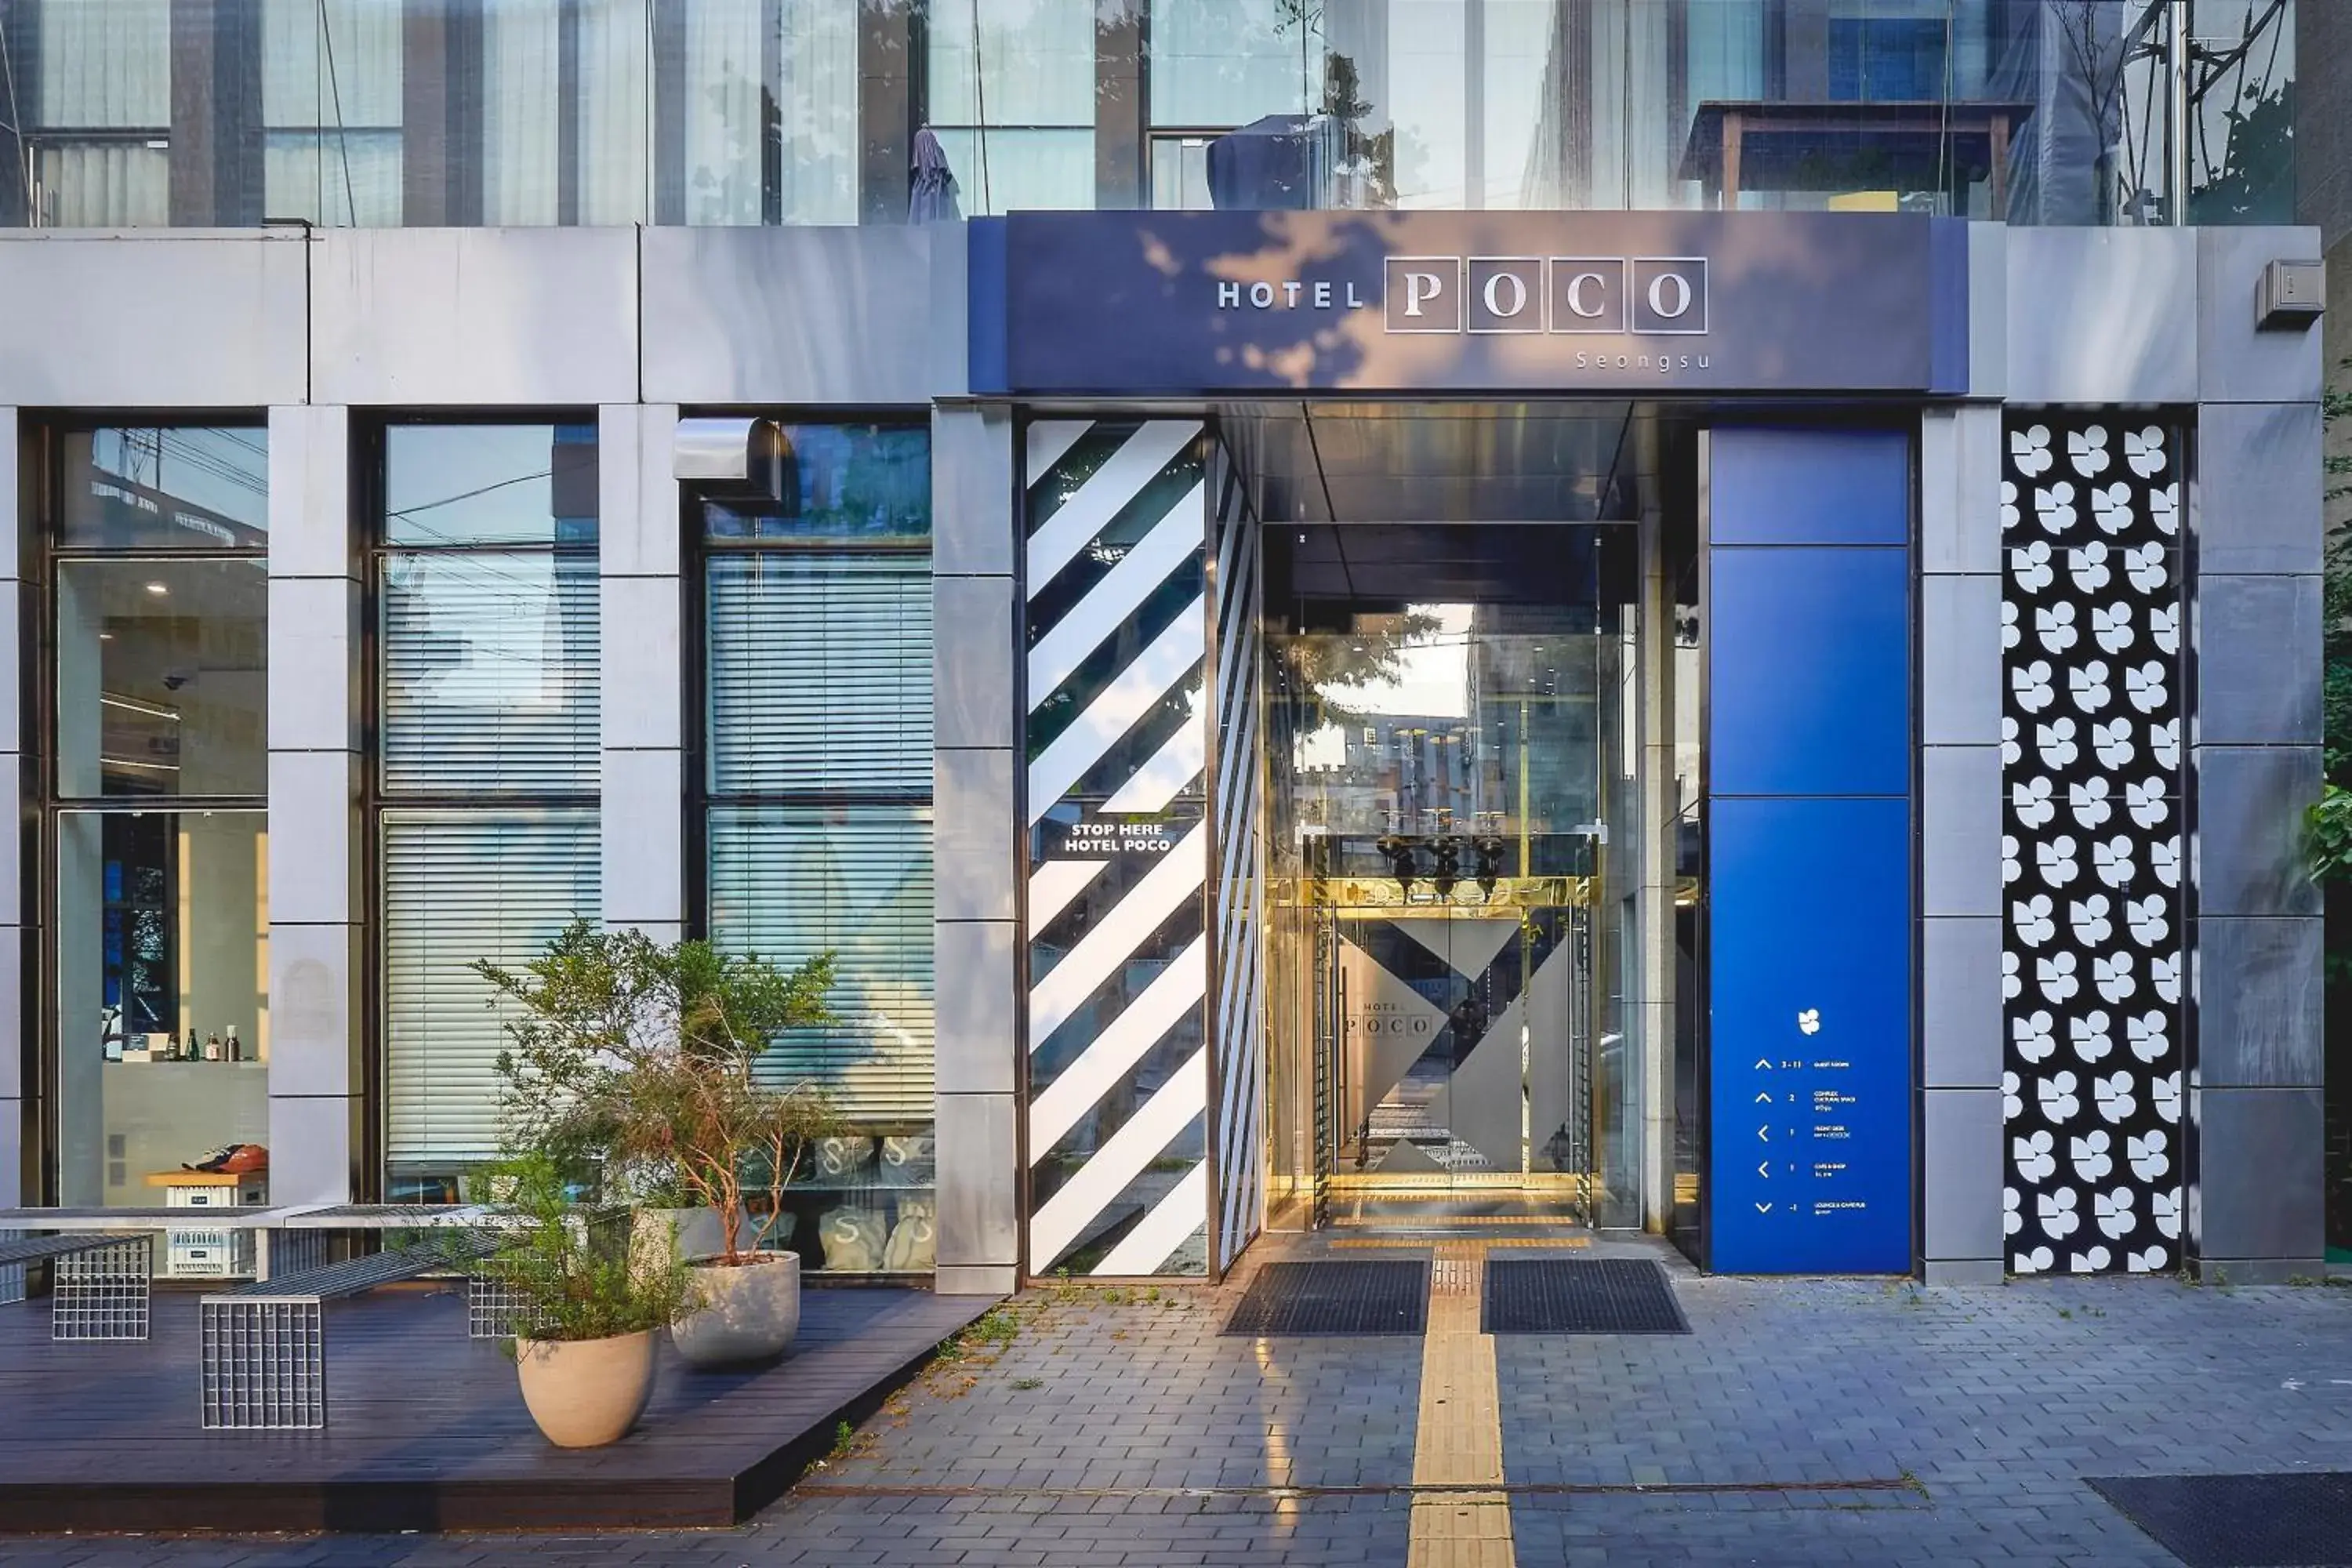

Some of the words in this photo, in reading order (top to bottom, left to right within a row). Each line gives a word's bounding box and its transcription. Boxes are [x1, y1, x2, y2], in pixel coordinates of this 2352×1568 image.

[1218, 281, 1364, 310] HOTEL
[1403, 272, 1692, 318] POCO
[1576, 350, 1710, 372] Seongsu
[1072, 824, 1115, 836] STOP
[1119, 824, 1163, 836] HERE
[1065, 840, 1120, 851] HOTEL
[1124, 840, 1171, 851] POCO
[1345, 1018, 1427, 1033] POCO
